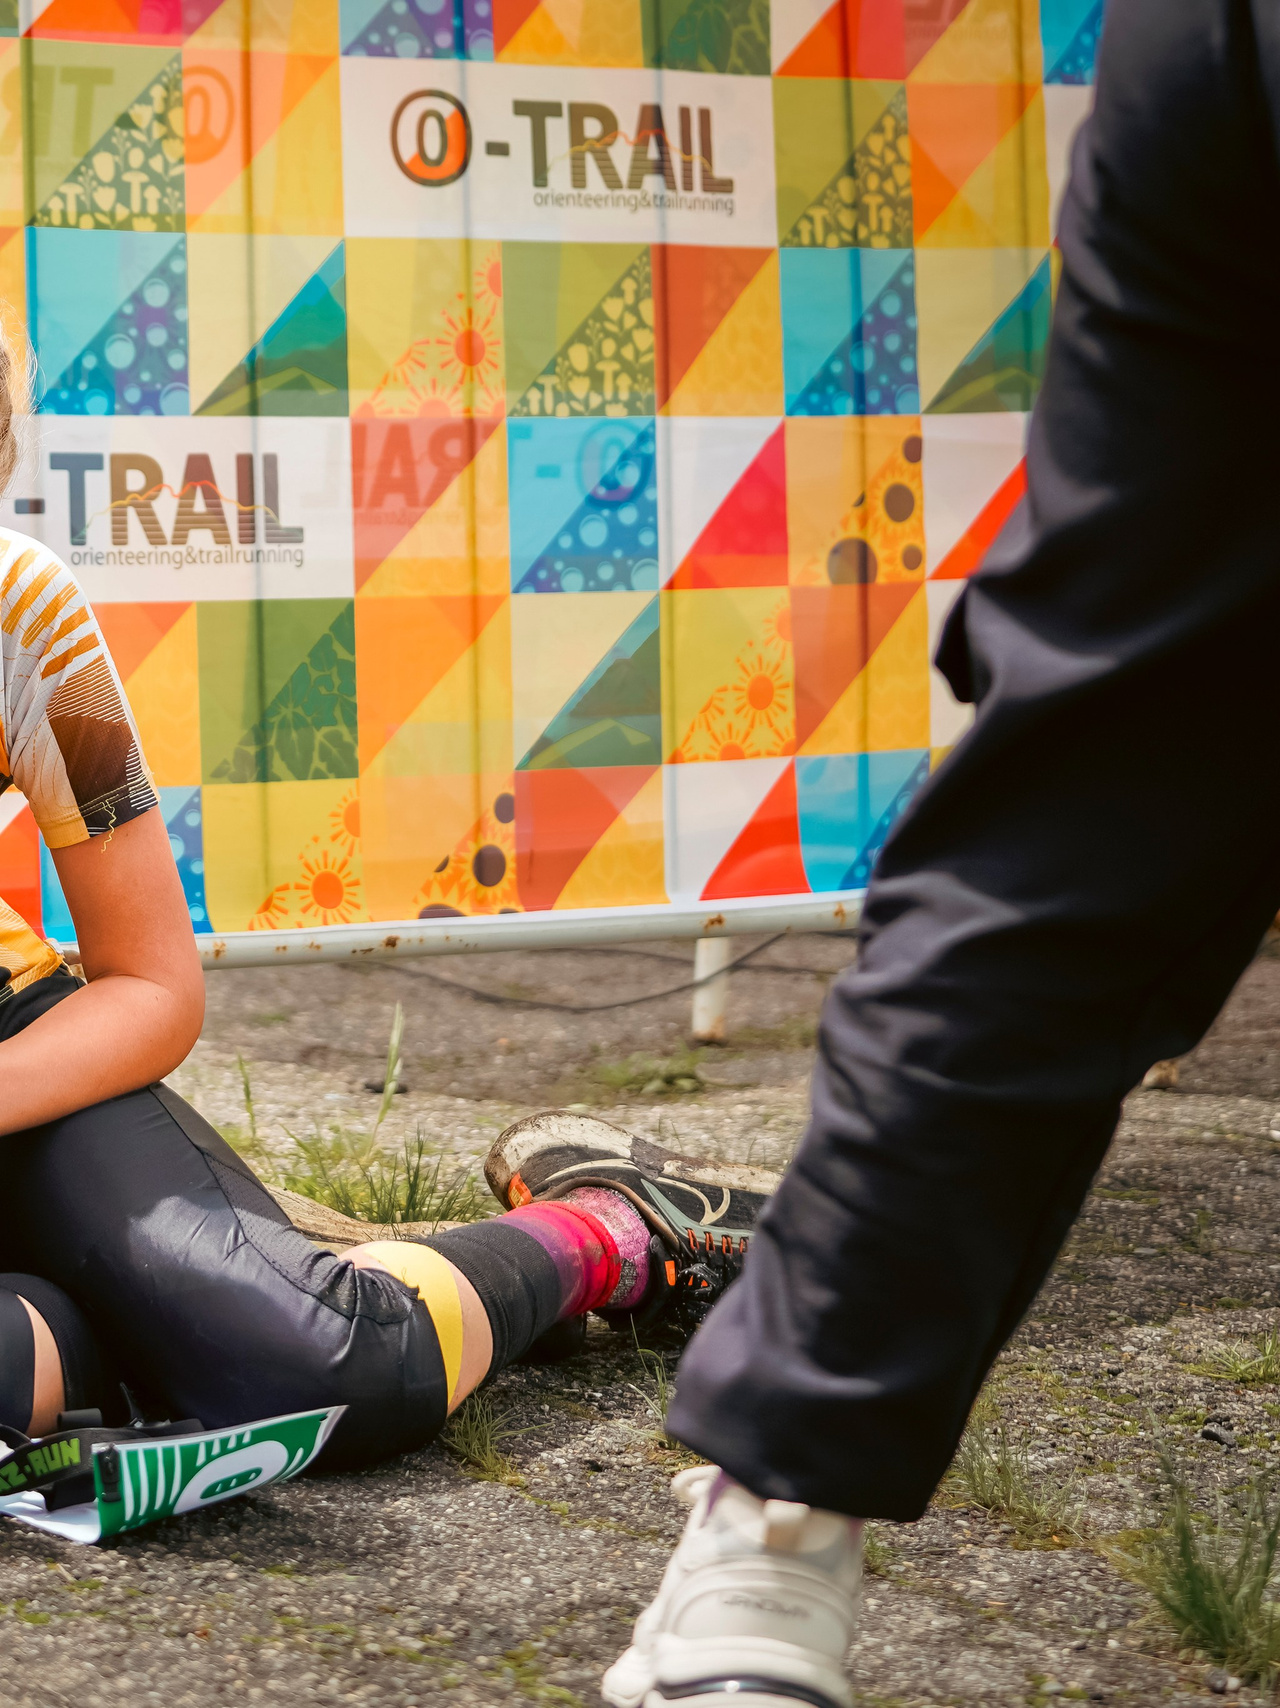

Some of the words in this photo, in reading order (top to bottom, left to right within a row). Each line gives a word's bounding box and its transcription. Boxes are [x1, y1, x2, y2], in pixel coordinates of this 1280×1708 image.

[534, 190, 734, 216] orienteering&trailrunning
[4, 453, 303, 546] -TRAIL
[70, 546, 304, 569] orienteering&trailrunning
